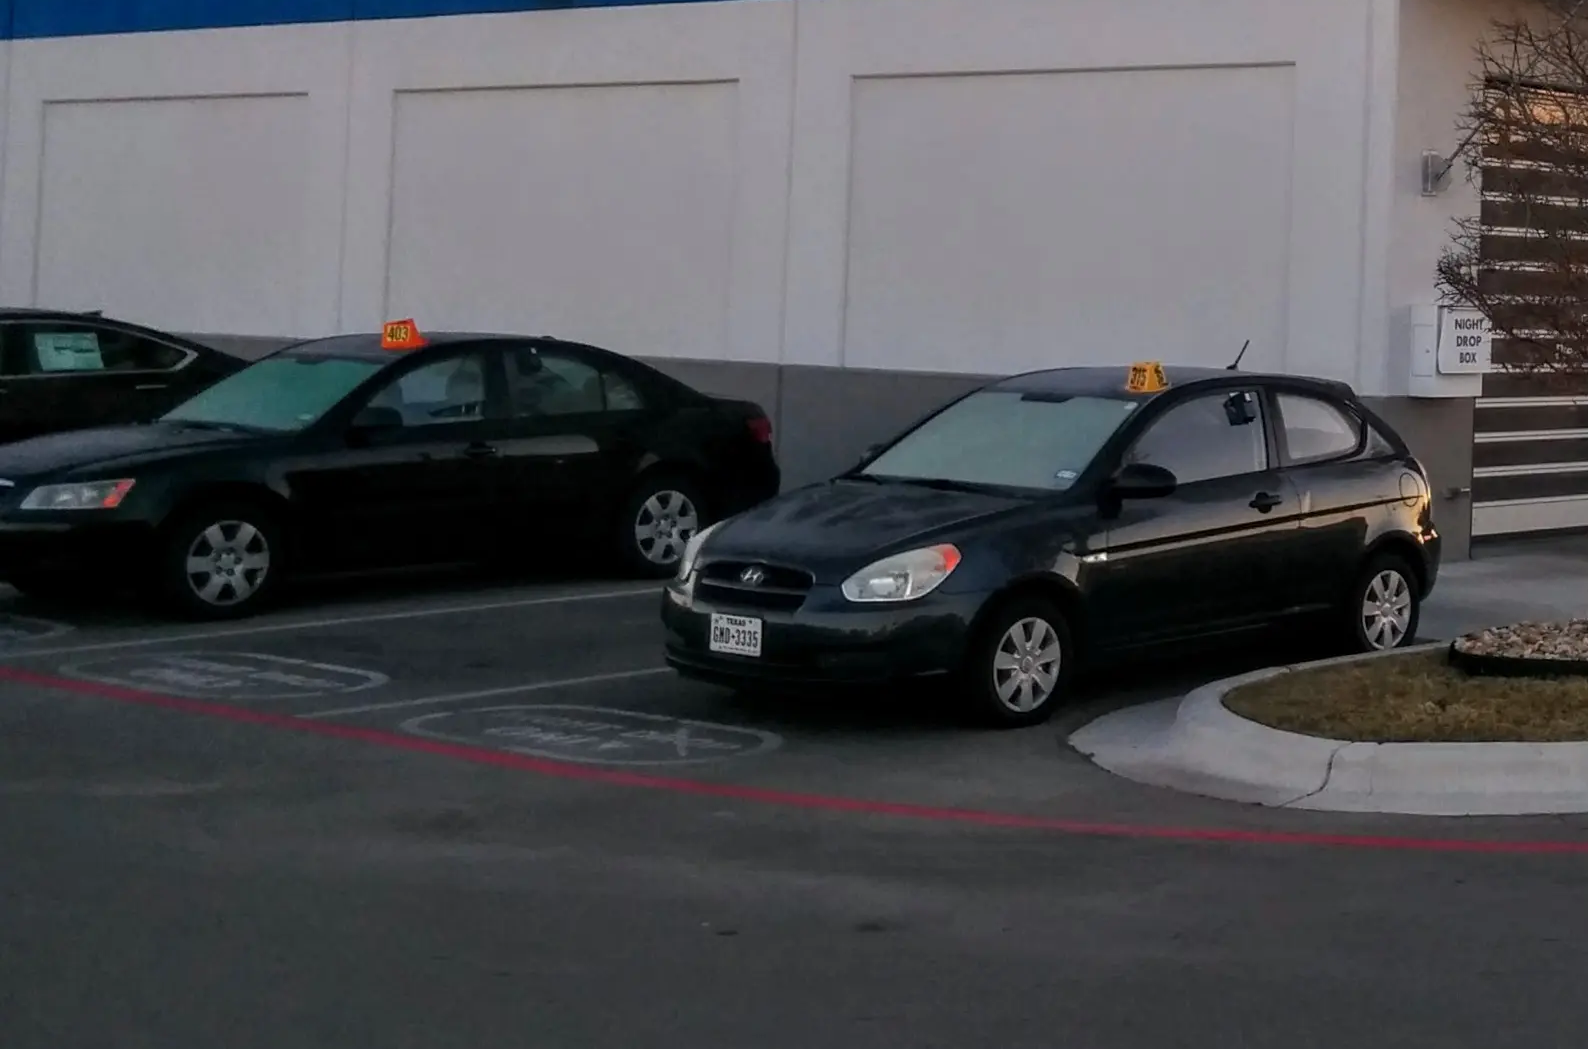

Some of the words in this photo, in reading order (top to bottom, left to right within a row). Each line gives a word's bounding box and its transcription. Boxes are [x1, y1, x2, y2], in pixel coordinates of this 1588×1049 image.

[1454, 317, 1486, 331] NIGHT
[1456, 335, 1482, 347] DROP
[1459, 352, 1477, 364] BOX
[726, 617, 747, 627] TEXAS
